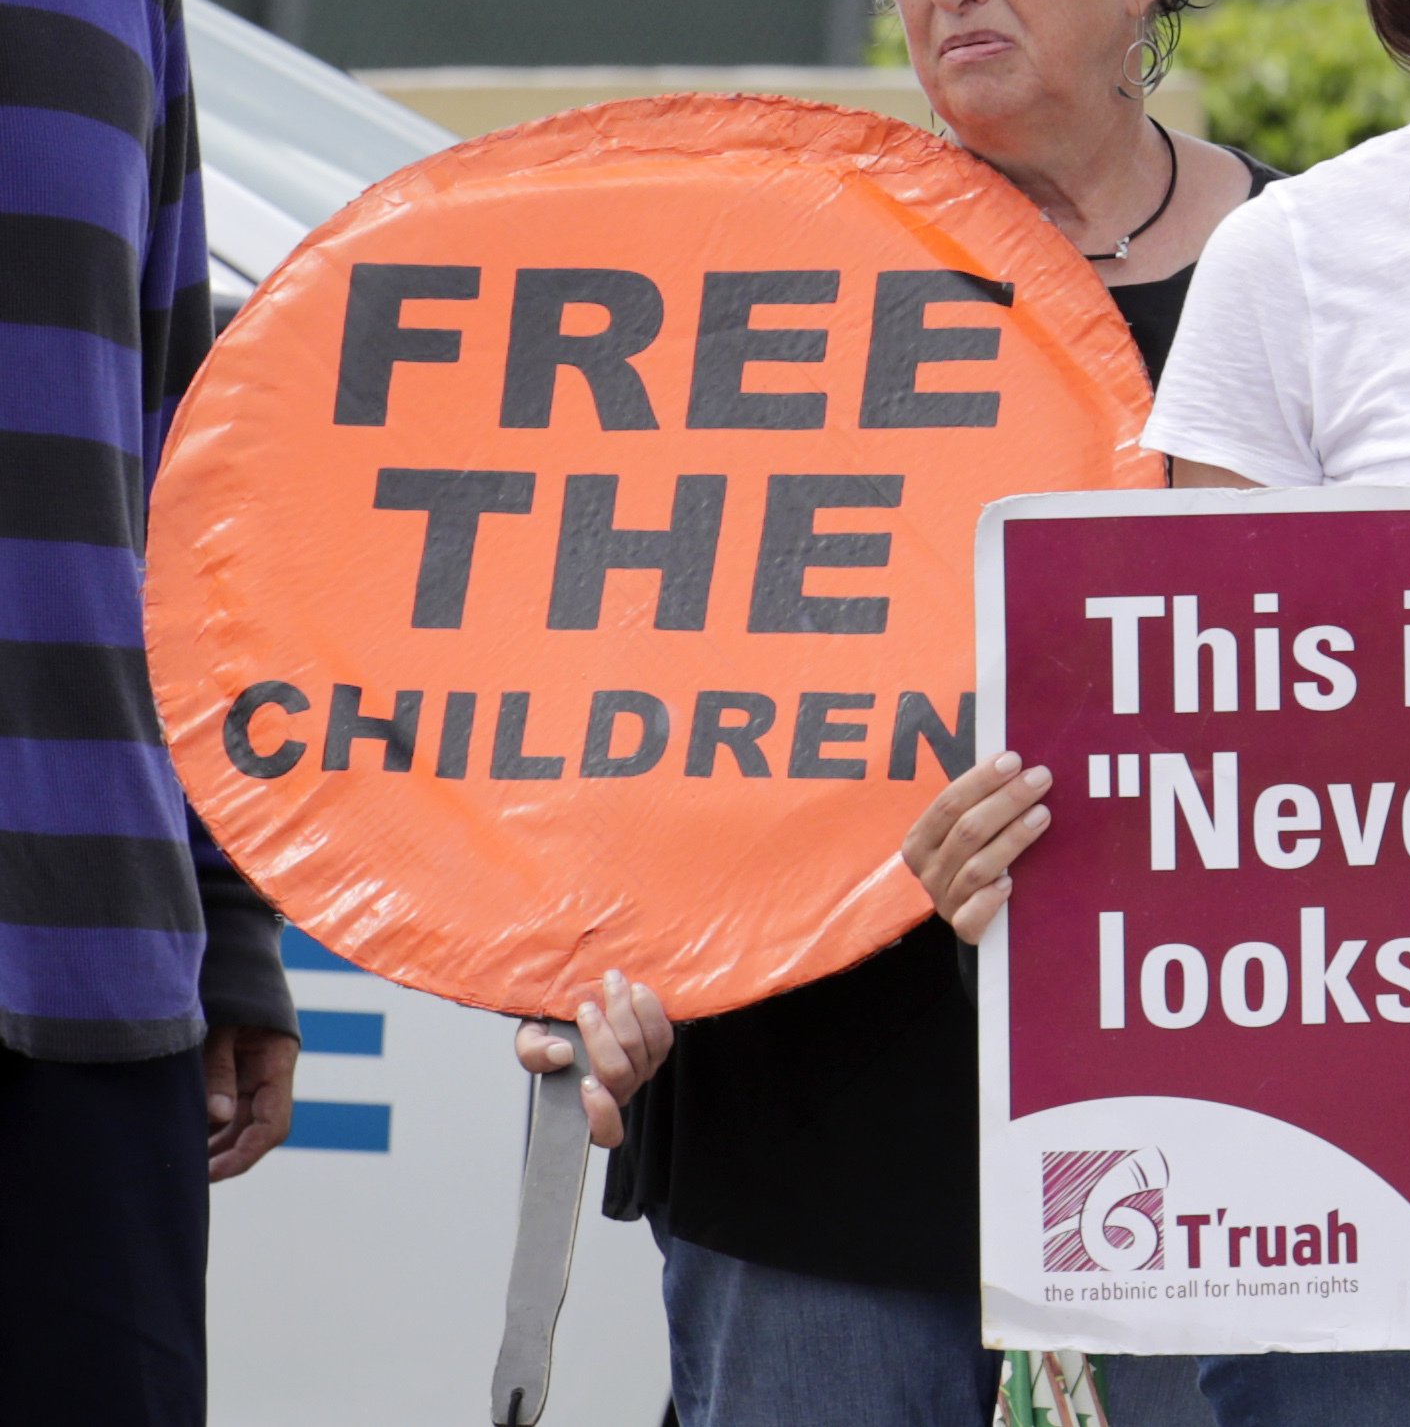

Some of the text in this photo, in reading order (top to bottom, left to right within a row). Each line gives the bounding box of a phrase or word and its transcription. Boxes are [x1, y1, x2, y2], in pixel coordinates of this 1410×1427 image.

[333, 262, 1016, 432] FREE
[372, 467, 906, 635] THE
[1084, 591, 1358, 715] This
[222, 679, 976, 783] CHILDREN
[1044, 1275, 1360, 1302] the rabbinic call for human rights
[1176, 1207, 1359, 1270] T'ruah
